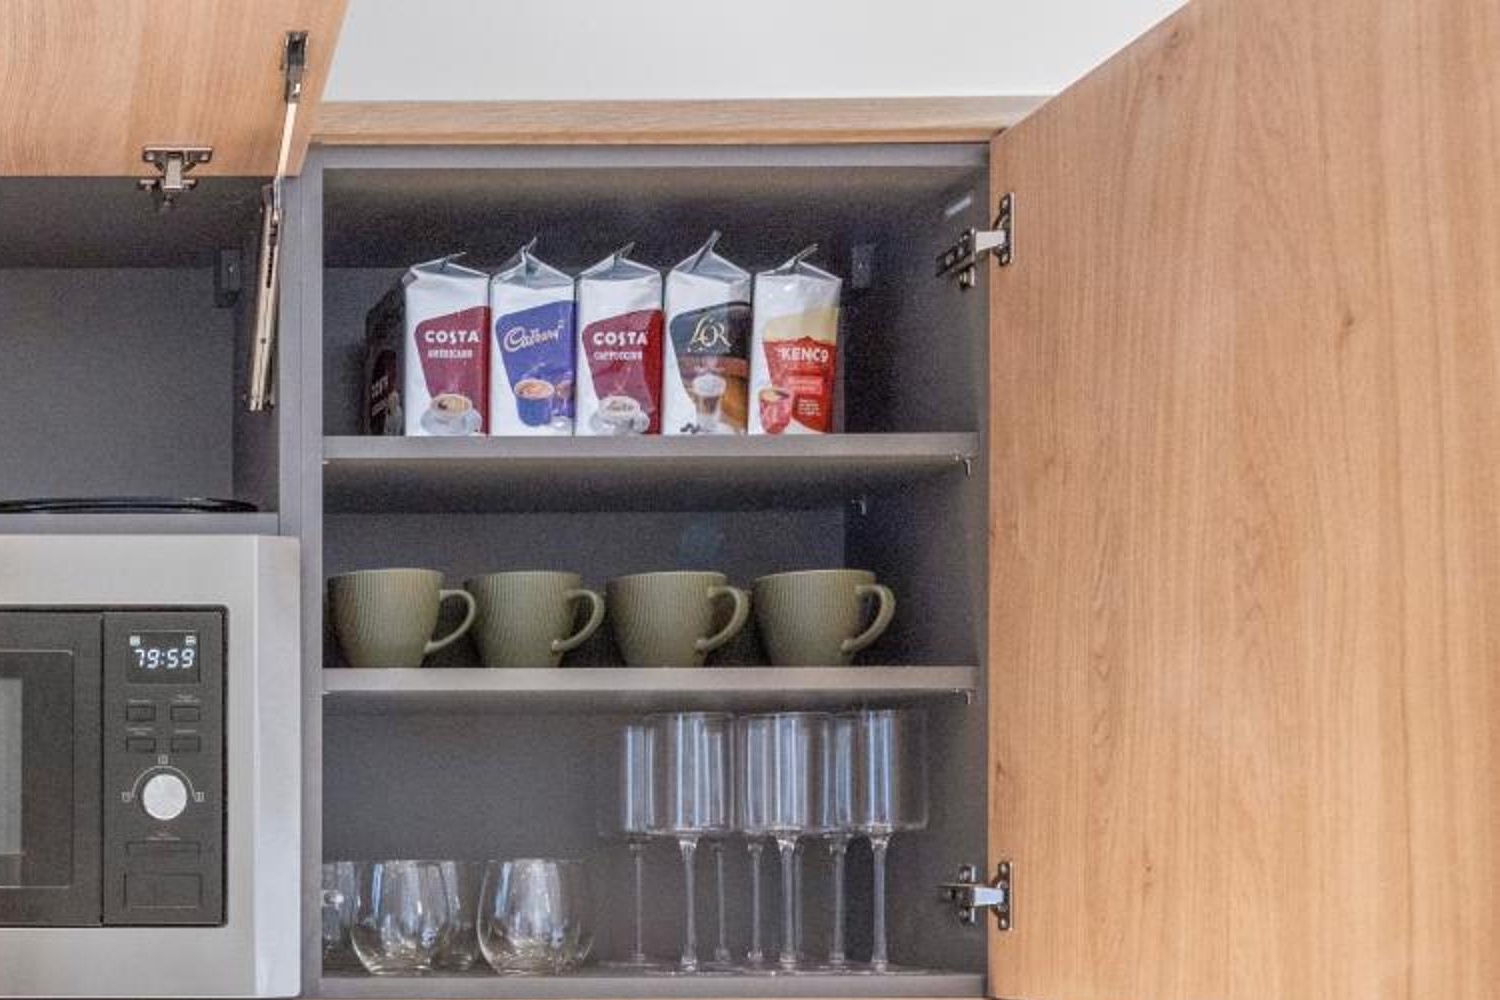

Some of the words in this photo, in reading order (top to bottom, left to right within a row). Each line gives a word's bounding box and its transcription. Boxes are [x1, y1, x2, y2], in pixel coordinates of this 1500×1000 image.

[424, 330, 480, 344] COSTA
[593, 331, 648, 346] COSTA
[133, 648, 196, 670] 79:59
